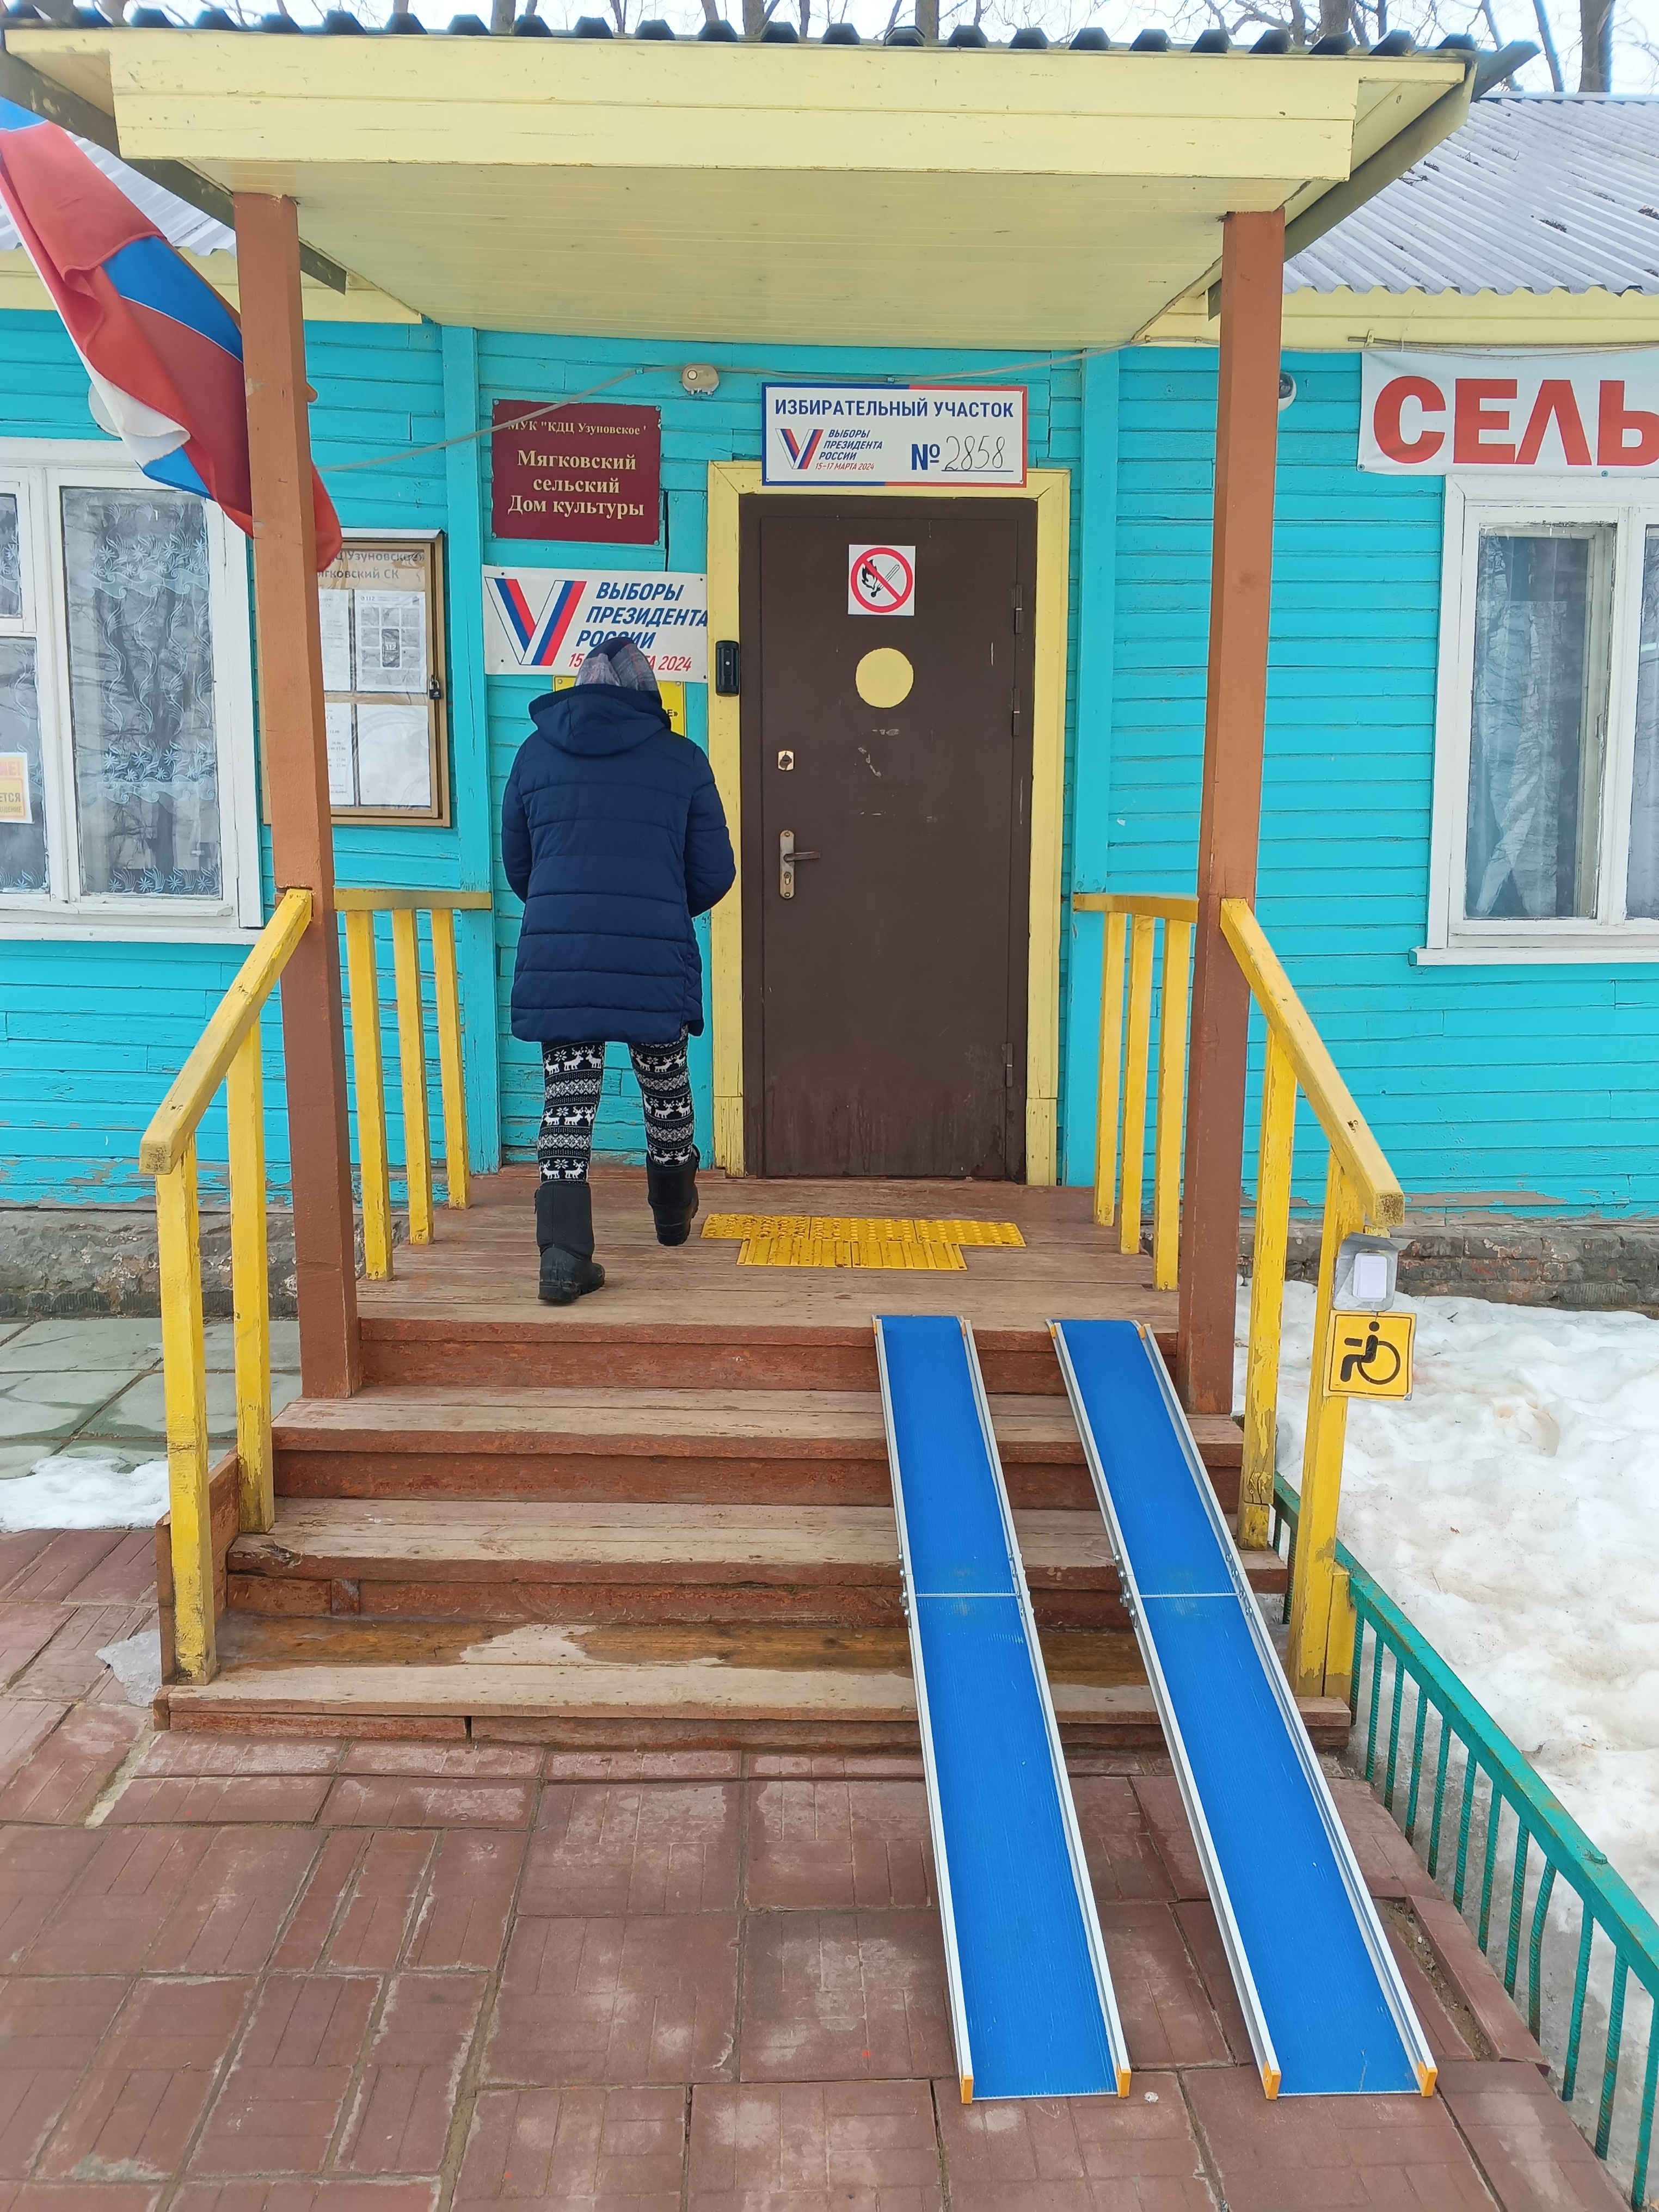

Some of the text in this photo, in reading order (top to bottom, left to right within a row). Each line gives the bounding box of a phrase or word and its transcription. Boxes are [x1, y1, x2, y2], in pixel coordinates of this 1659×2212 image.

[775, 398, 1013, 417] ИЗБИРАТЕЛЬНЫЙ УЧАСТОК
[828, 429, 871, 438] ВЫБОРЫ
[823, 440, 883, 451] ПРЕЗИДЕНТА
[944, 435, 1005, 470] 2858
[517, 450, 636, 470] Мягковский
[818, 452, 857, 460] РОССИИ
[533, 477, 620, 493] сельский
[507, 495, 644, 519] Дом культуры
[318, 567, 399, 579] ягковский СК
[595, 582, 684, 601] ВЫБОРЫ
[586, 606, 708, 627] ПРЕЗИДЕНТА
[658, 655, 692, 671] 2024
